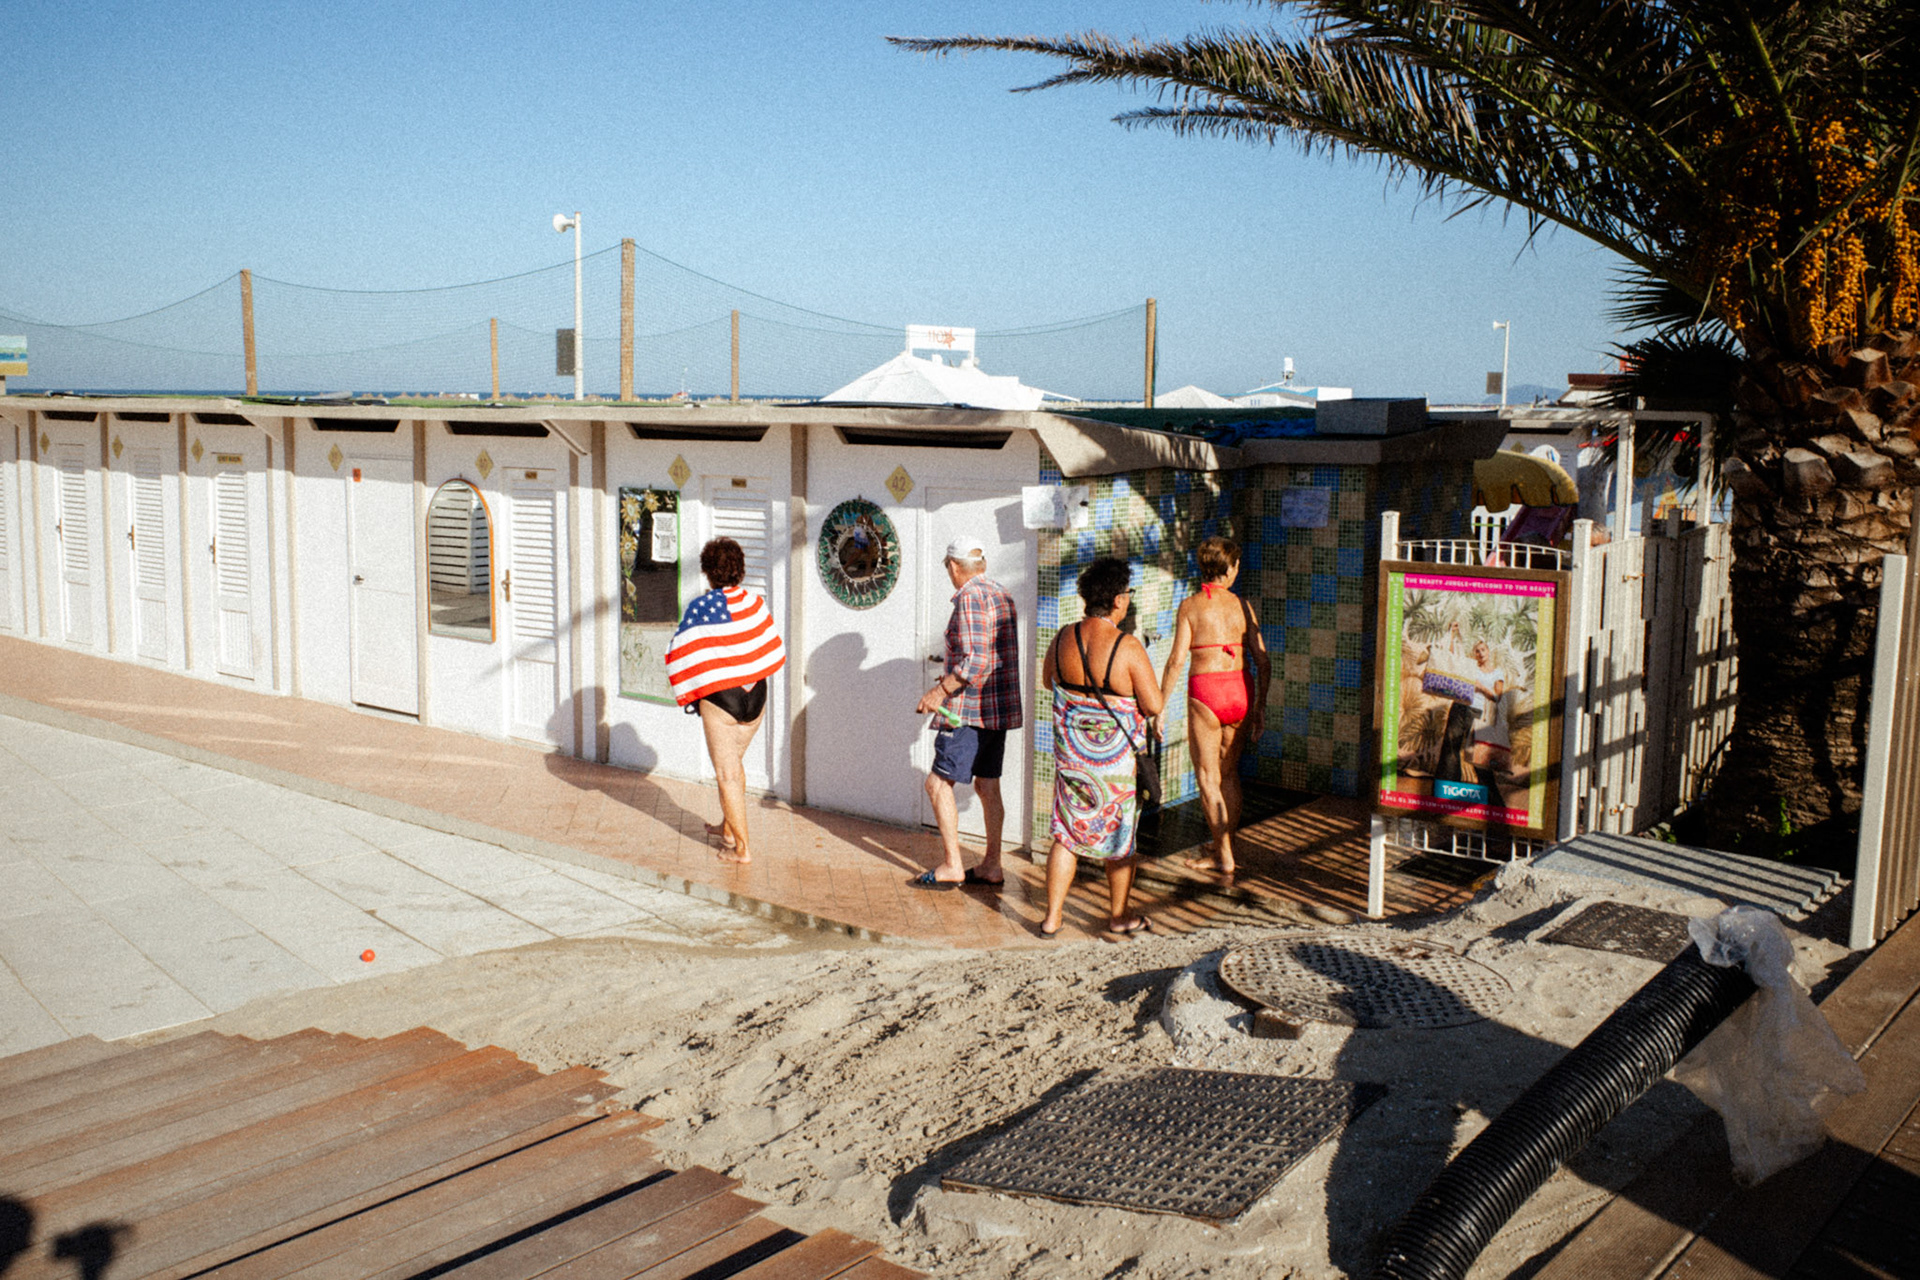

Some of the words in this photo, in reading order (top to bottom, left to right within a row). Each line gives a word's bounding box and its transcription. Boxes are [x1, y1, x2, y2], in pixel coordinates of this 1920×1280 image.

[892, 475, 906, 492] 42
[1419, 578, 1443, 586] BEAUTY
[1529, 585, 1556, 593] BEAUTY
